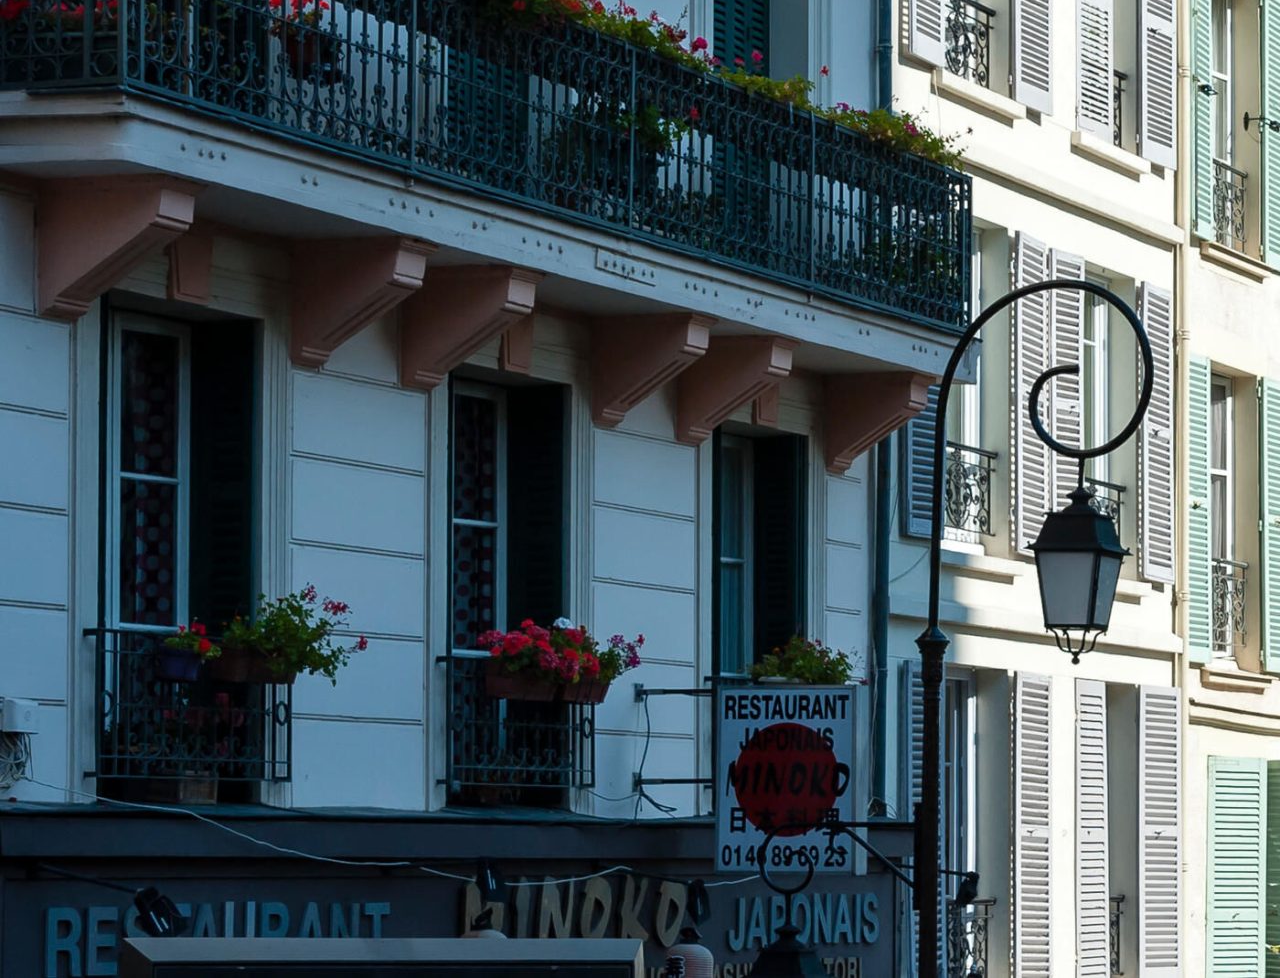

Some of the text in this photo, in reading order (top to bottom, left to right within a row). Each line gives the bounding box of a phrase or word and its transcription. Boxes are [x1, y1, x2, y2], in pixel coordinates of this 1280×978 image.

[724, 694, 849, 720] RESTAURANT
[739, 727, 835, 751] JAPONAIS
[726, 760, 850, 797] MINOKO
[728, 892, 880, 953] JAPONAIS
